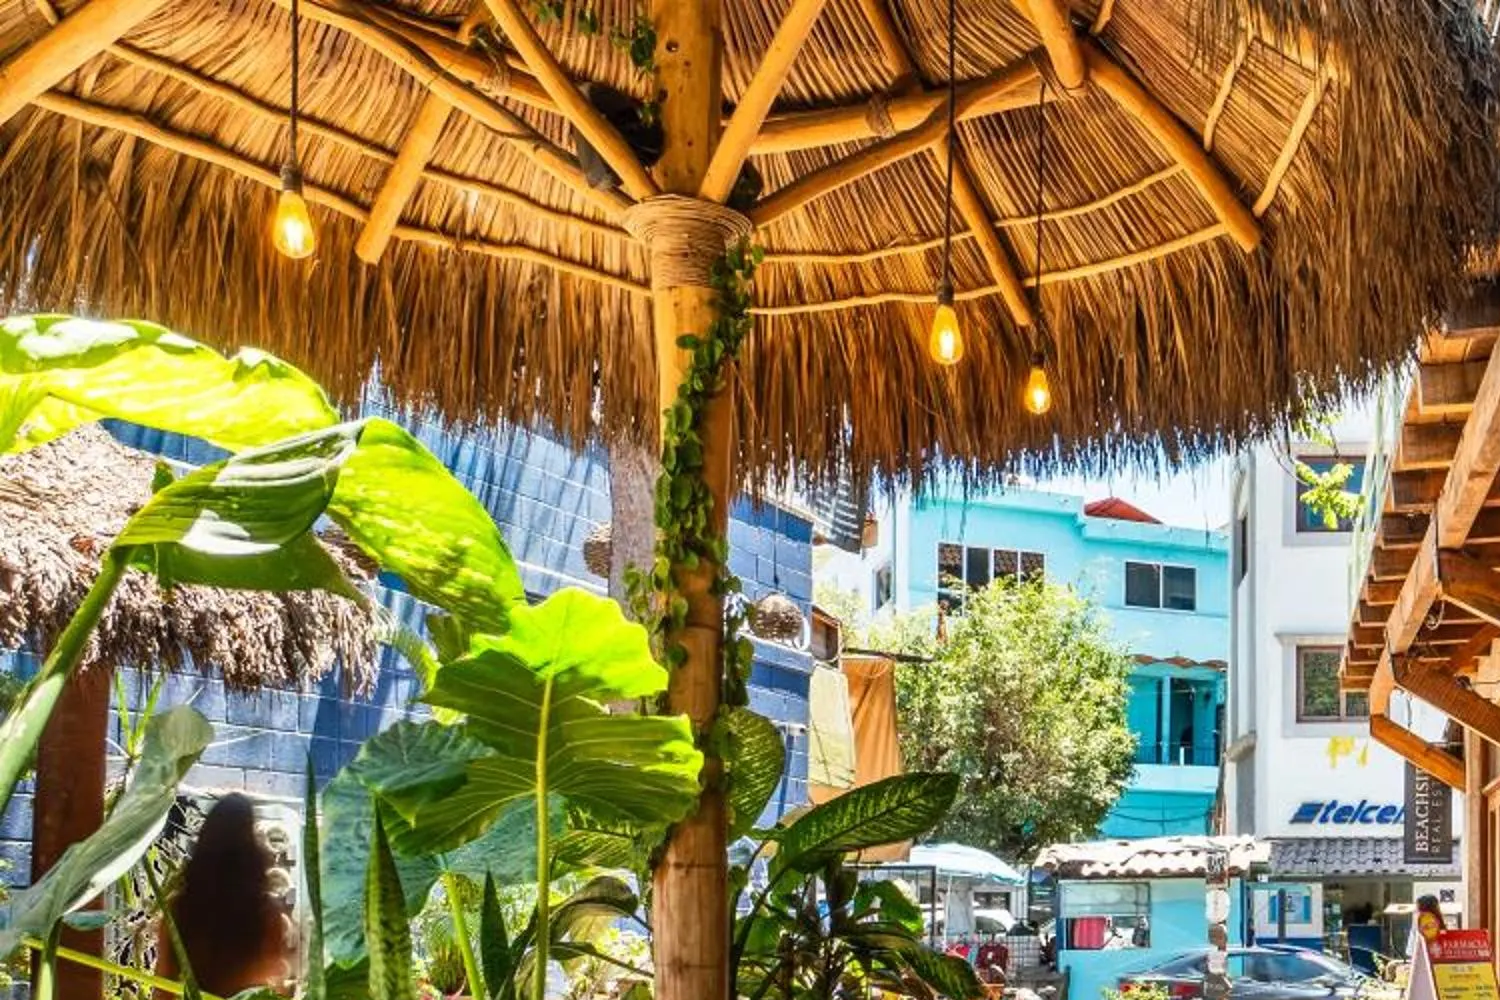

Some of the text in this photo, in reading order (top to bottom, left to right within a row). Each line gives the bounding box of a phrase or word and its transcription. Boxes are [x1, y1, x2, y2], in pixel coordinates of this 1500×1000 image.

[1431, 781, 1441, 853] REAL EST
[1442, 939, 1489, 950] FARMACIA
